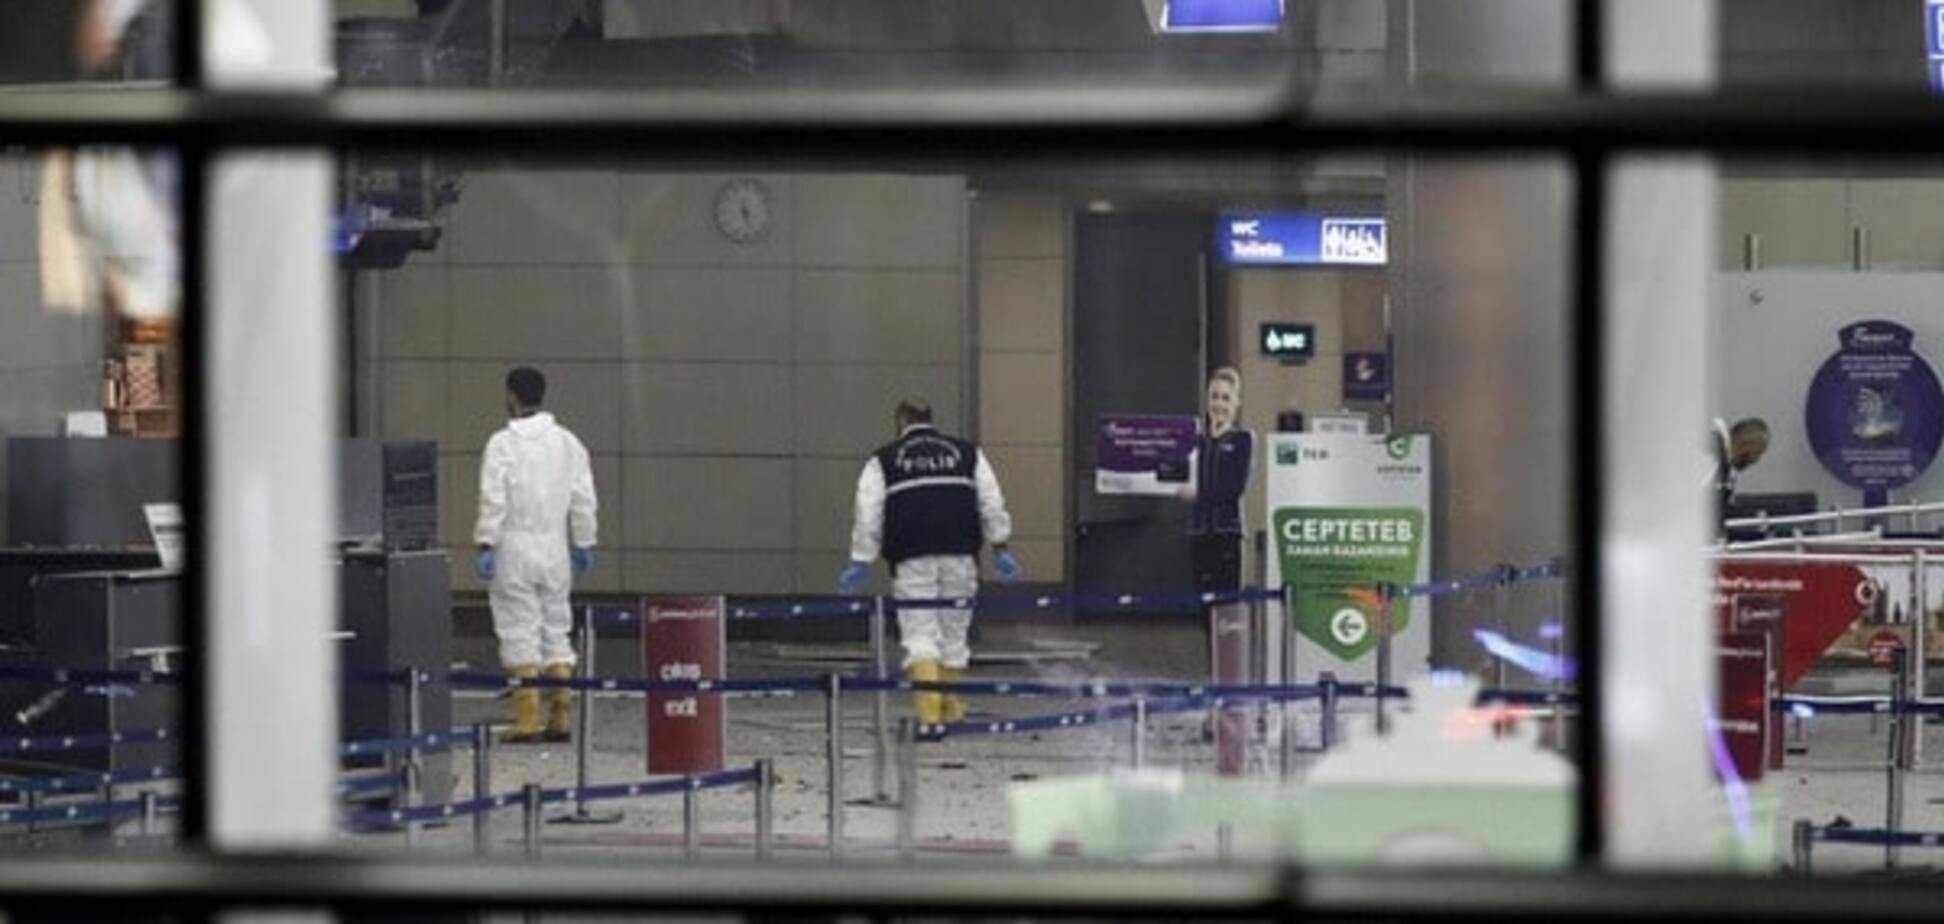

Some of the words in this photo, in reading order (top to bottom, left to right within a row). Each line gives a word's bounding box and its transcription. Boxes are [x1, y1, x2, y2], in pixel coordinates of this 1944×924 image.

[1231, 219, 1259, 236] WC
[1283, 518, 1413, 541] CEPTETEB
[664, 698, 698, 717] exit
